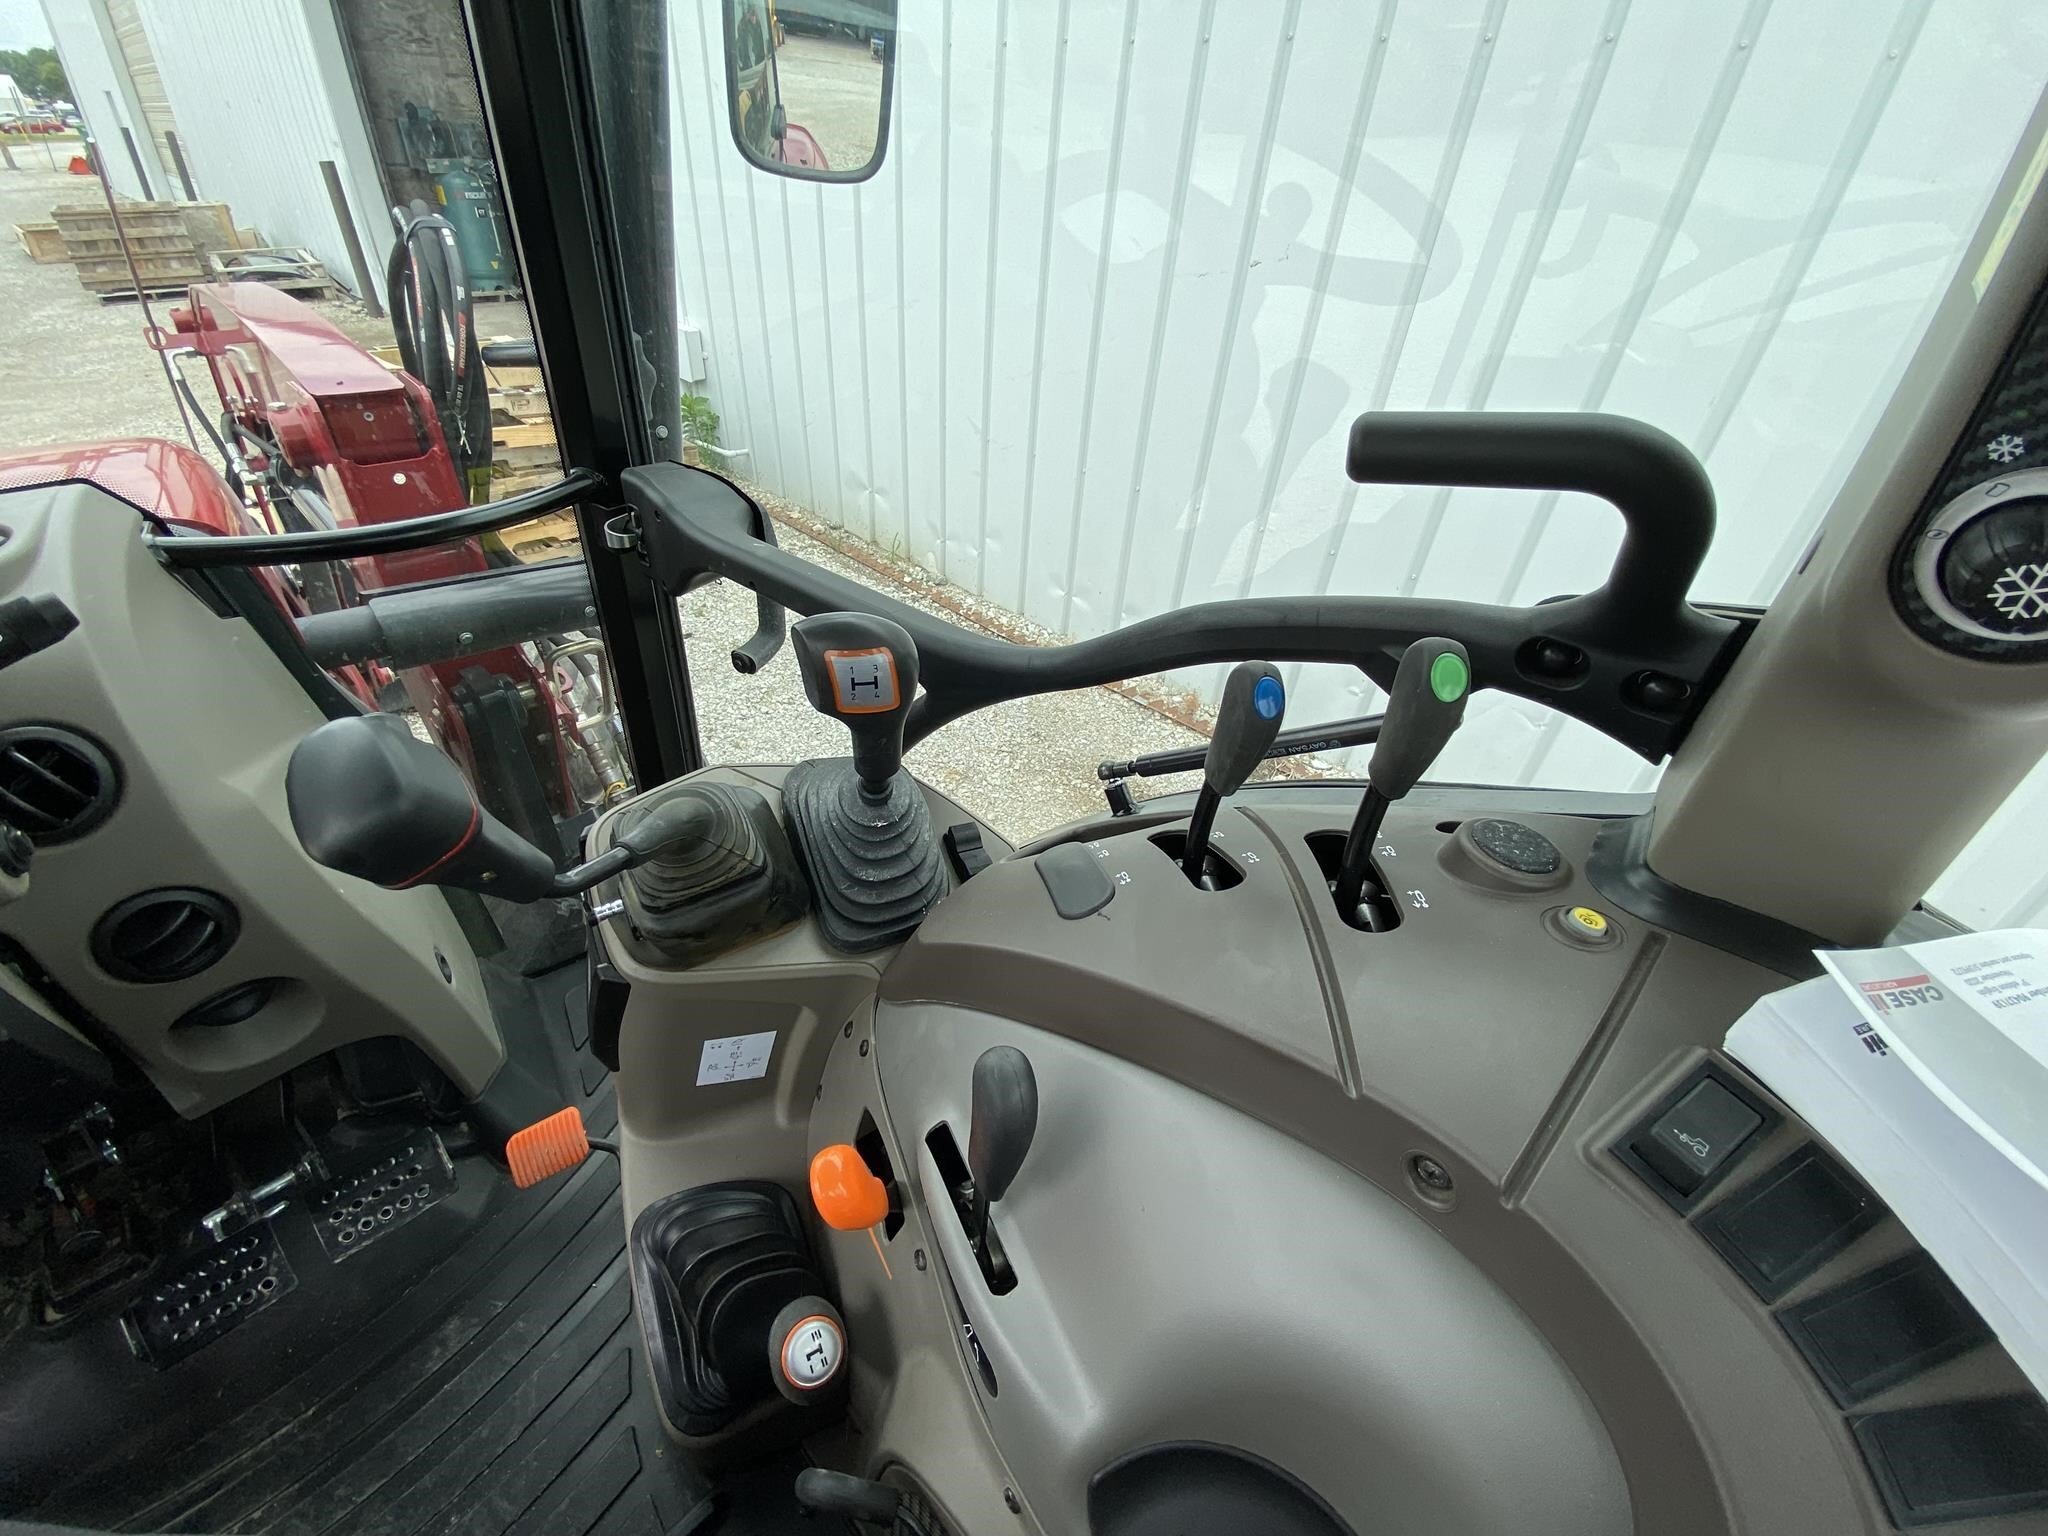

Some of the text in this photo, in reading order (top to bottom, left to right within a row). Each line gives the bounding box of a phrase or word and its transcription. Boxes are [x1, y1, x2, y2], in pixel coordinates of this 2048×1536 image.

[850, 664, 878, 674] 1 3
[874, 690, 880, 698] 4
[1886, 985, 1944, 1008] CASE
